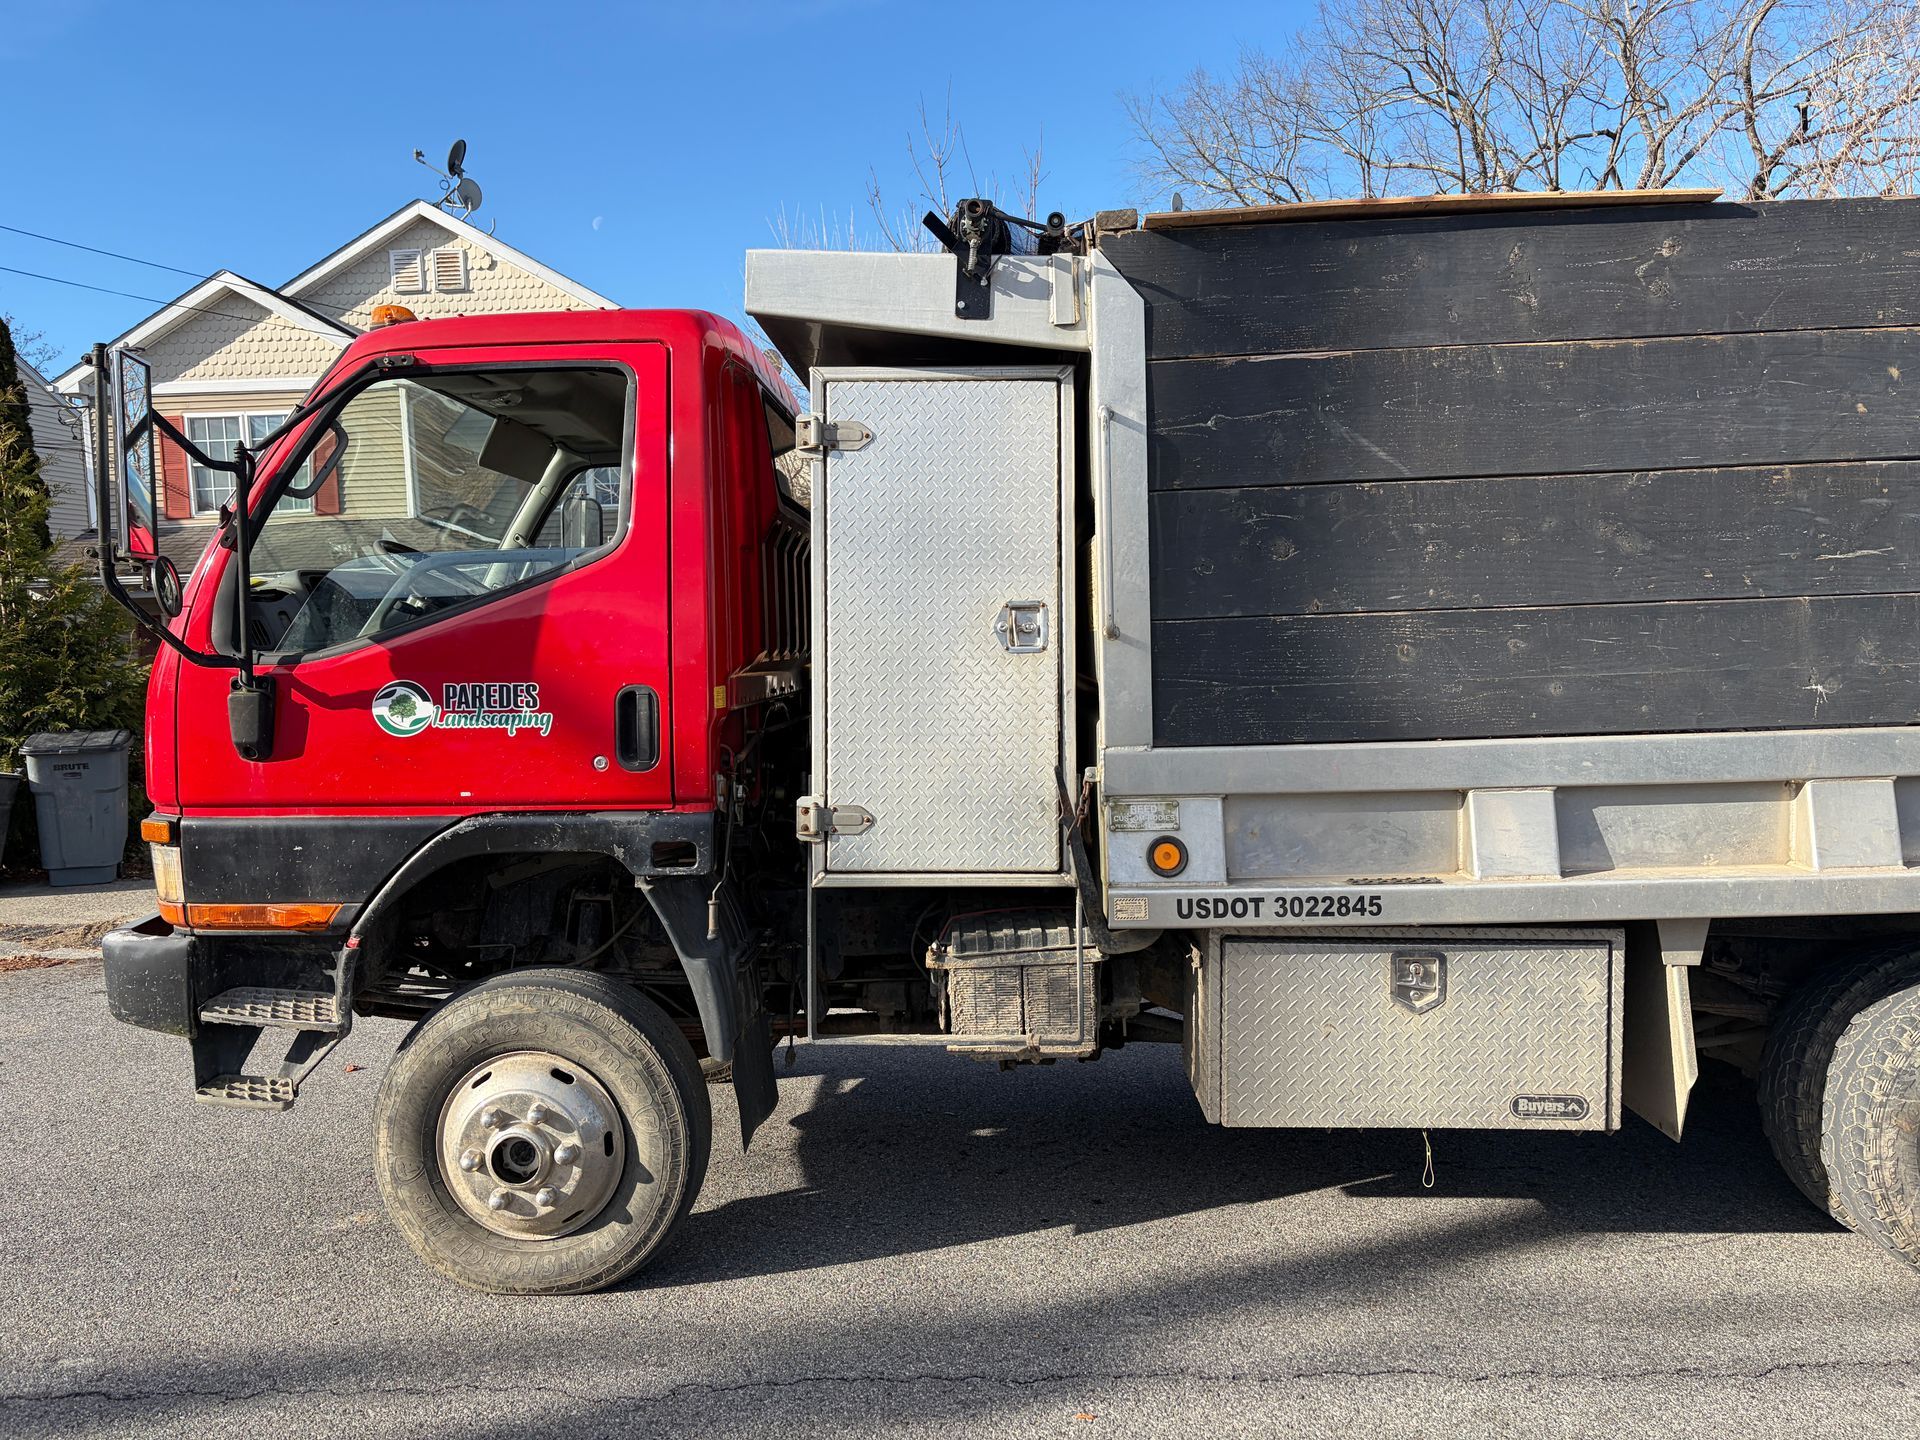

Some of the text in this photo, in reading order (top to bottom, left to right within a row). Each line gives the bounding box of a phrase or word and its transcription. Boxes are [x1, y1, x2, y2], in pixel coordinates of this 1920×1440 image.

[443, 683, 539, 711] PAREDES
[433, 706, 553, 735] Landscaping
[53, 763, 90, 771] BRUTE
[1176, 895, 1383, 919] USDOT 3022845
[435, 1018, 640, 1094] Firestone
[1518, 1098, 1566, 1115] Buyers
[451, 1225, 630, 1276] TRANSFORCE
